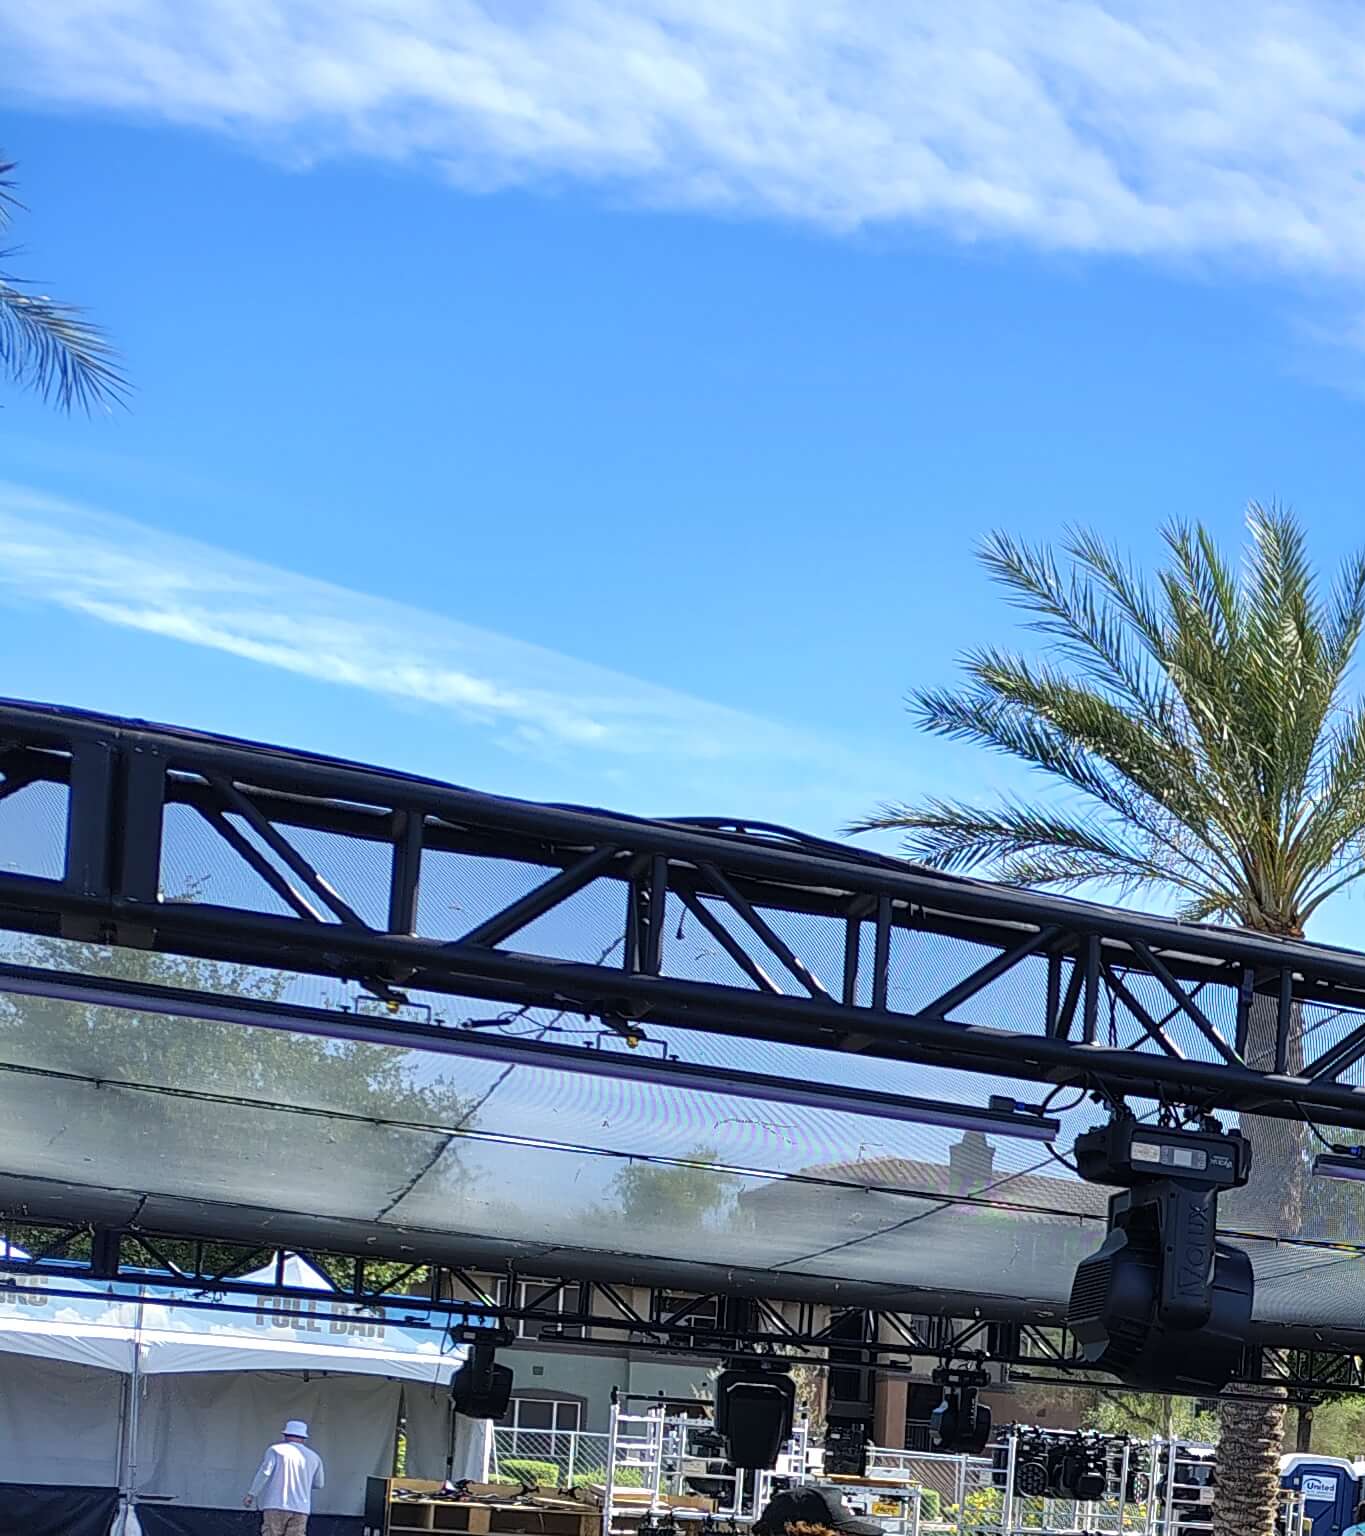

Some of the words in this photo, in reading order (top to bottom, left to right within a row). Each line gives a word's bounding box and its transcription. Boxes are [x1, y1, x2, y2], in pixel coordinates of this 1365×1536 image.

[256, 1294, 322, 1333] FULL
[329, 1300, 387, 1339] BAR
[1306, 1482, 1335, 1491] United
